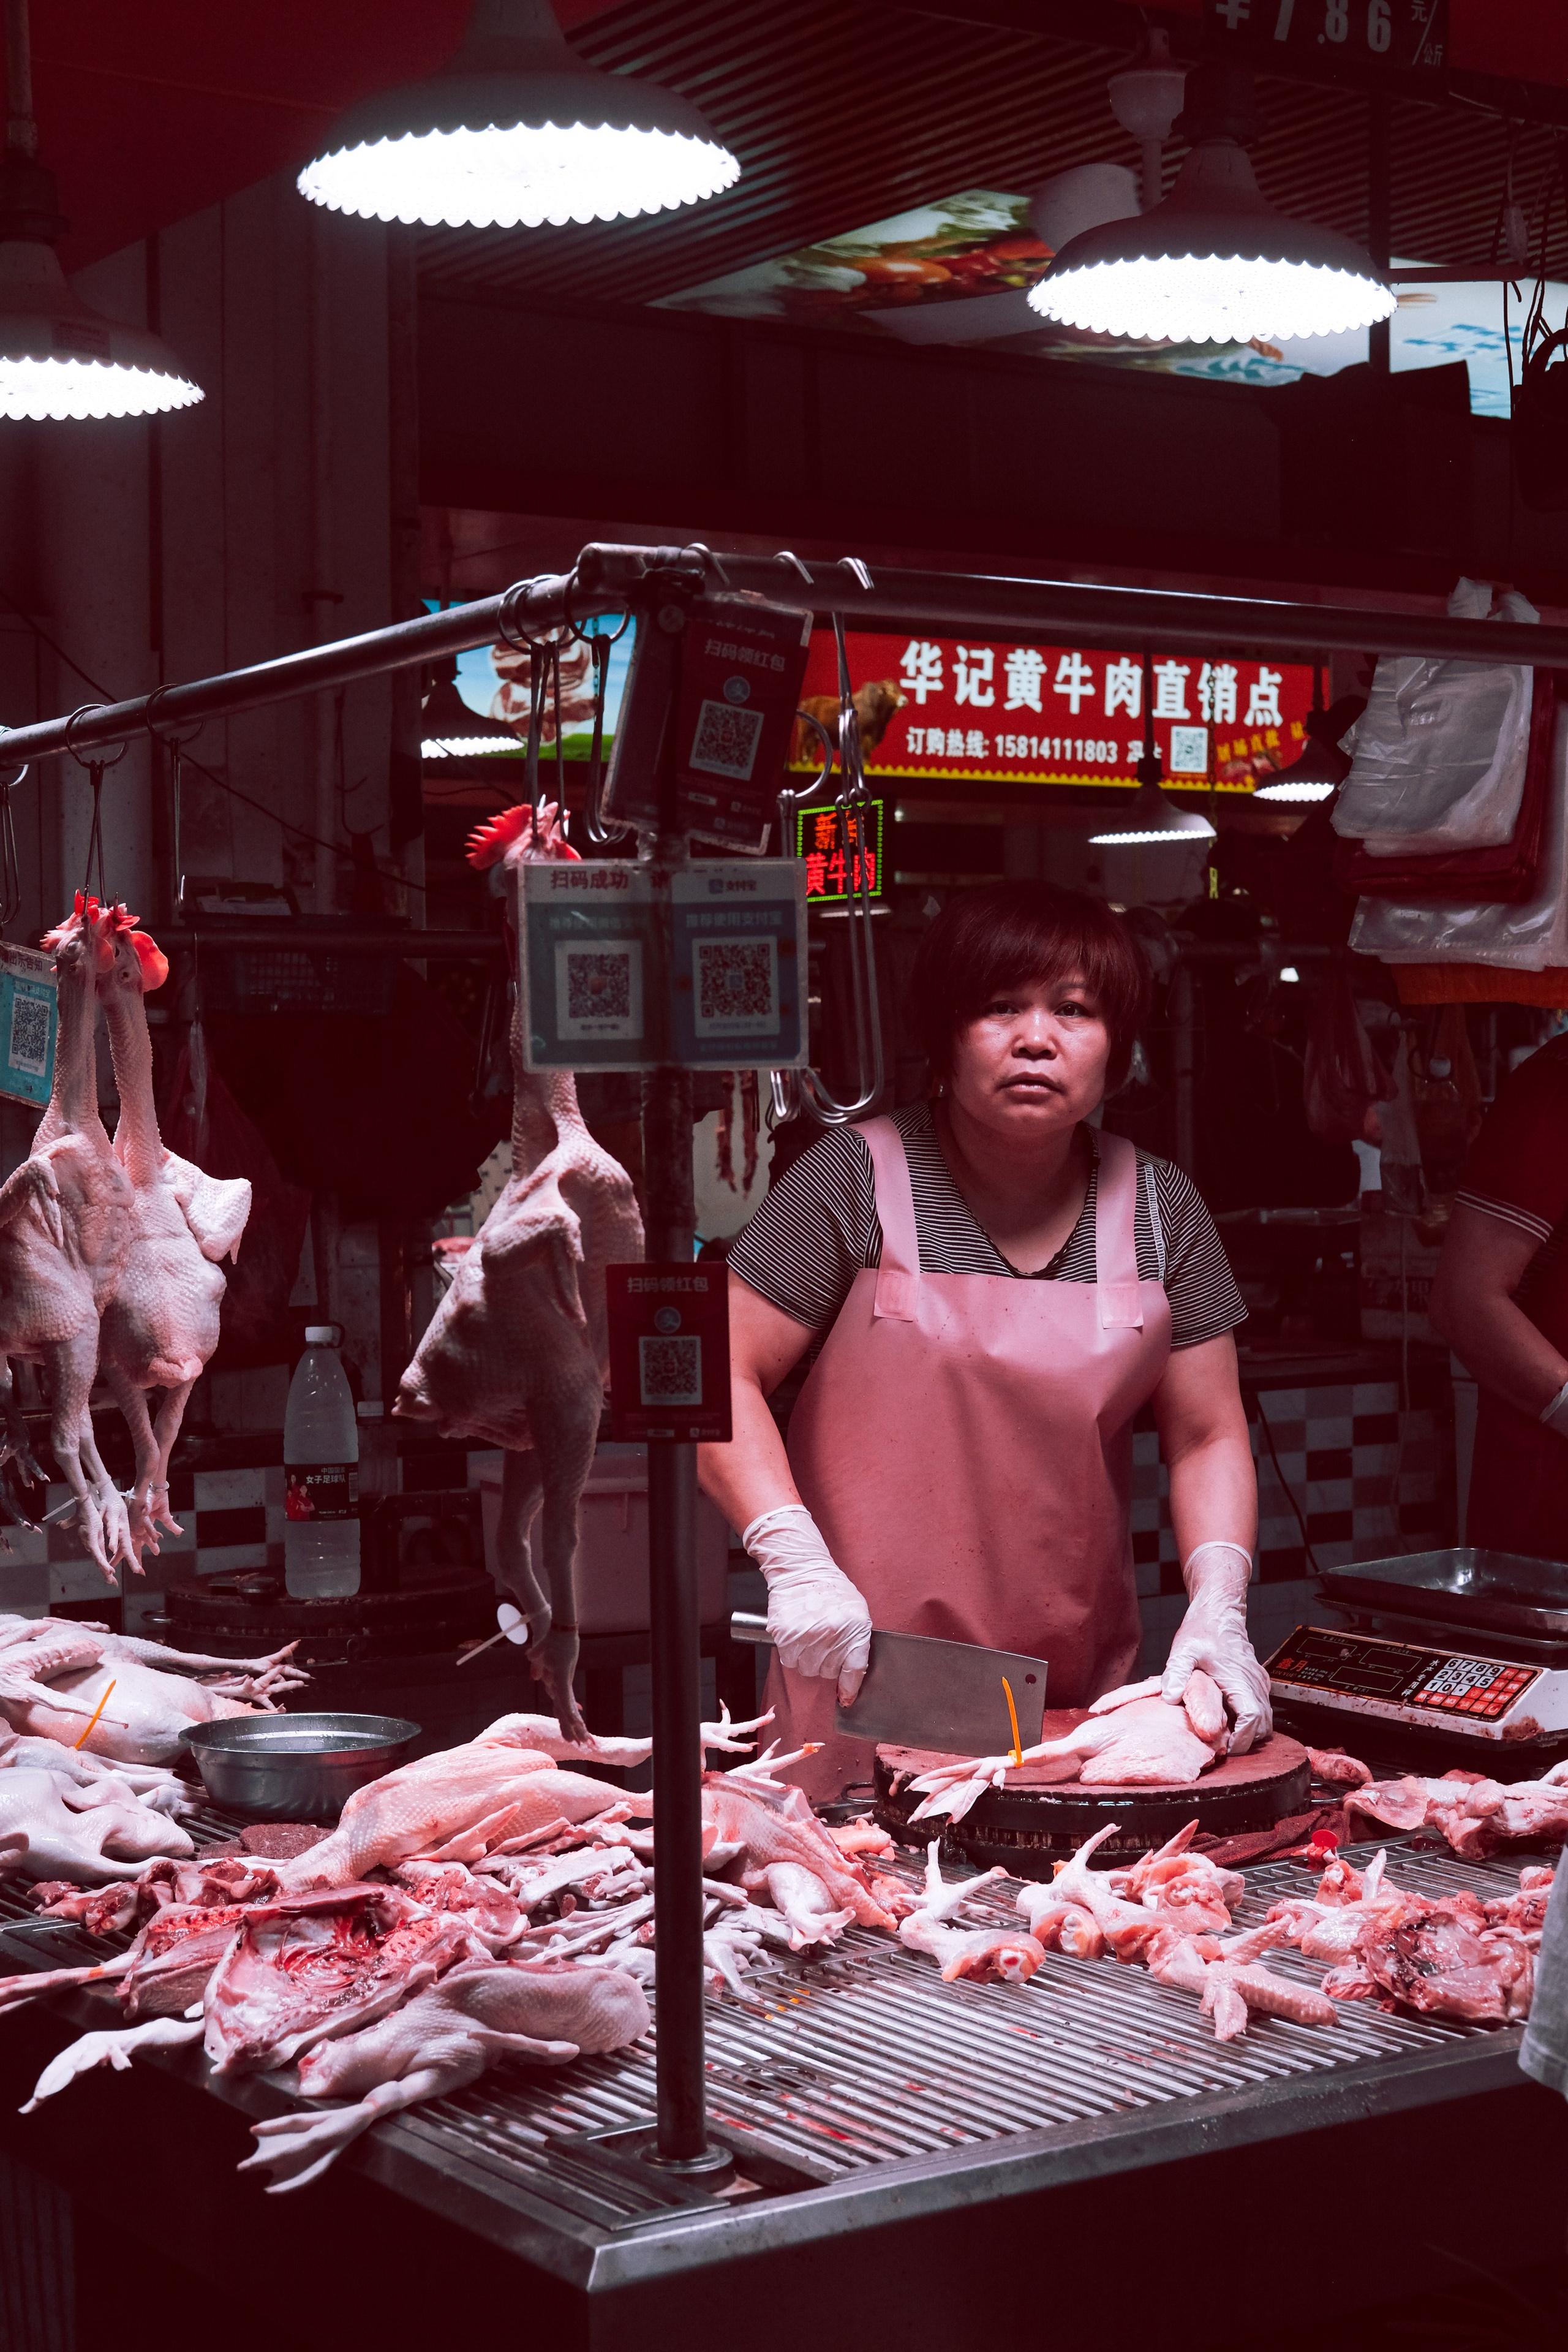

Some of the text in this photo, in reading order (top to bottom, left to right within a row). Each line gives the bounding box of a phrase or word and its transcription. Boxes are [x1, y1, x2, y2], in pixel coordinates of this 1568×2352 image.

[704, 638, 786, 672] 扫码领红包
[899, 640, 1284, 728] 华记黄牛肉直销点
[995, 734, 1118, 764] 15814111803
[551, 870, 629, 890] 扫码成功
[627, 1276, 709, 1293] 扫码领红包
[306, 1474, 346, 1484] 女子足球队
[1276, 1658, 1309, 1672] 鑫月
[1448, 1659, 1459, 1668] 6
[1490, 1667, 1501, 1676] 9
[1437, 1671, 1449, 1679] 2
